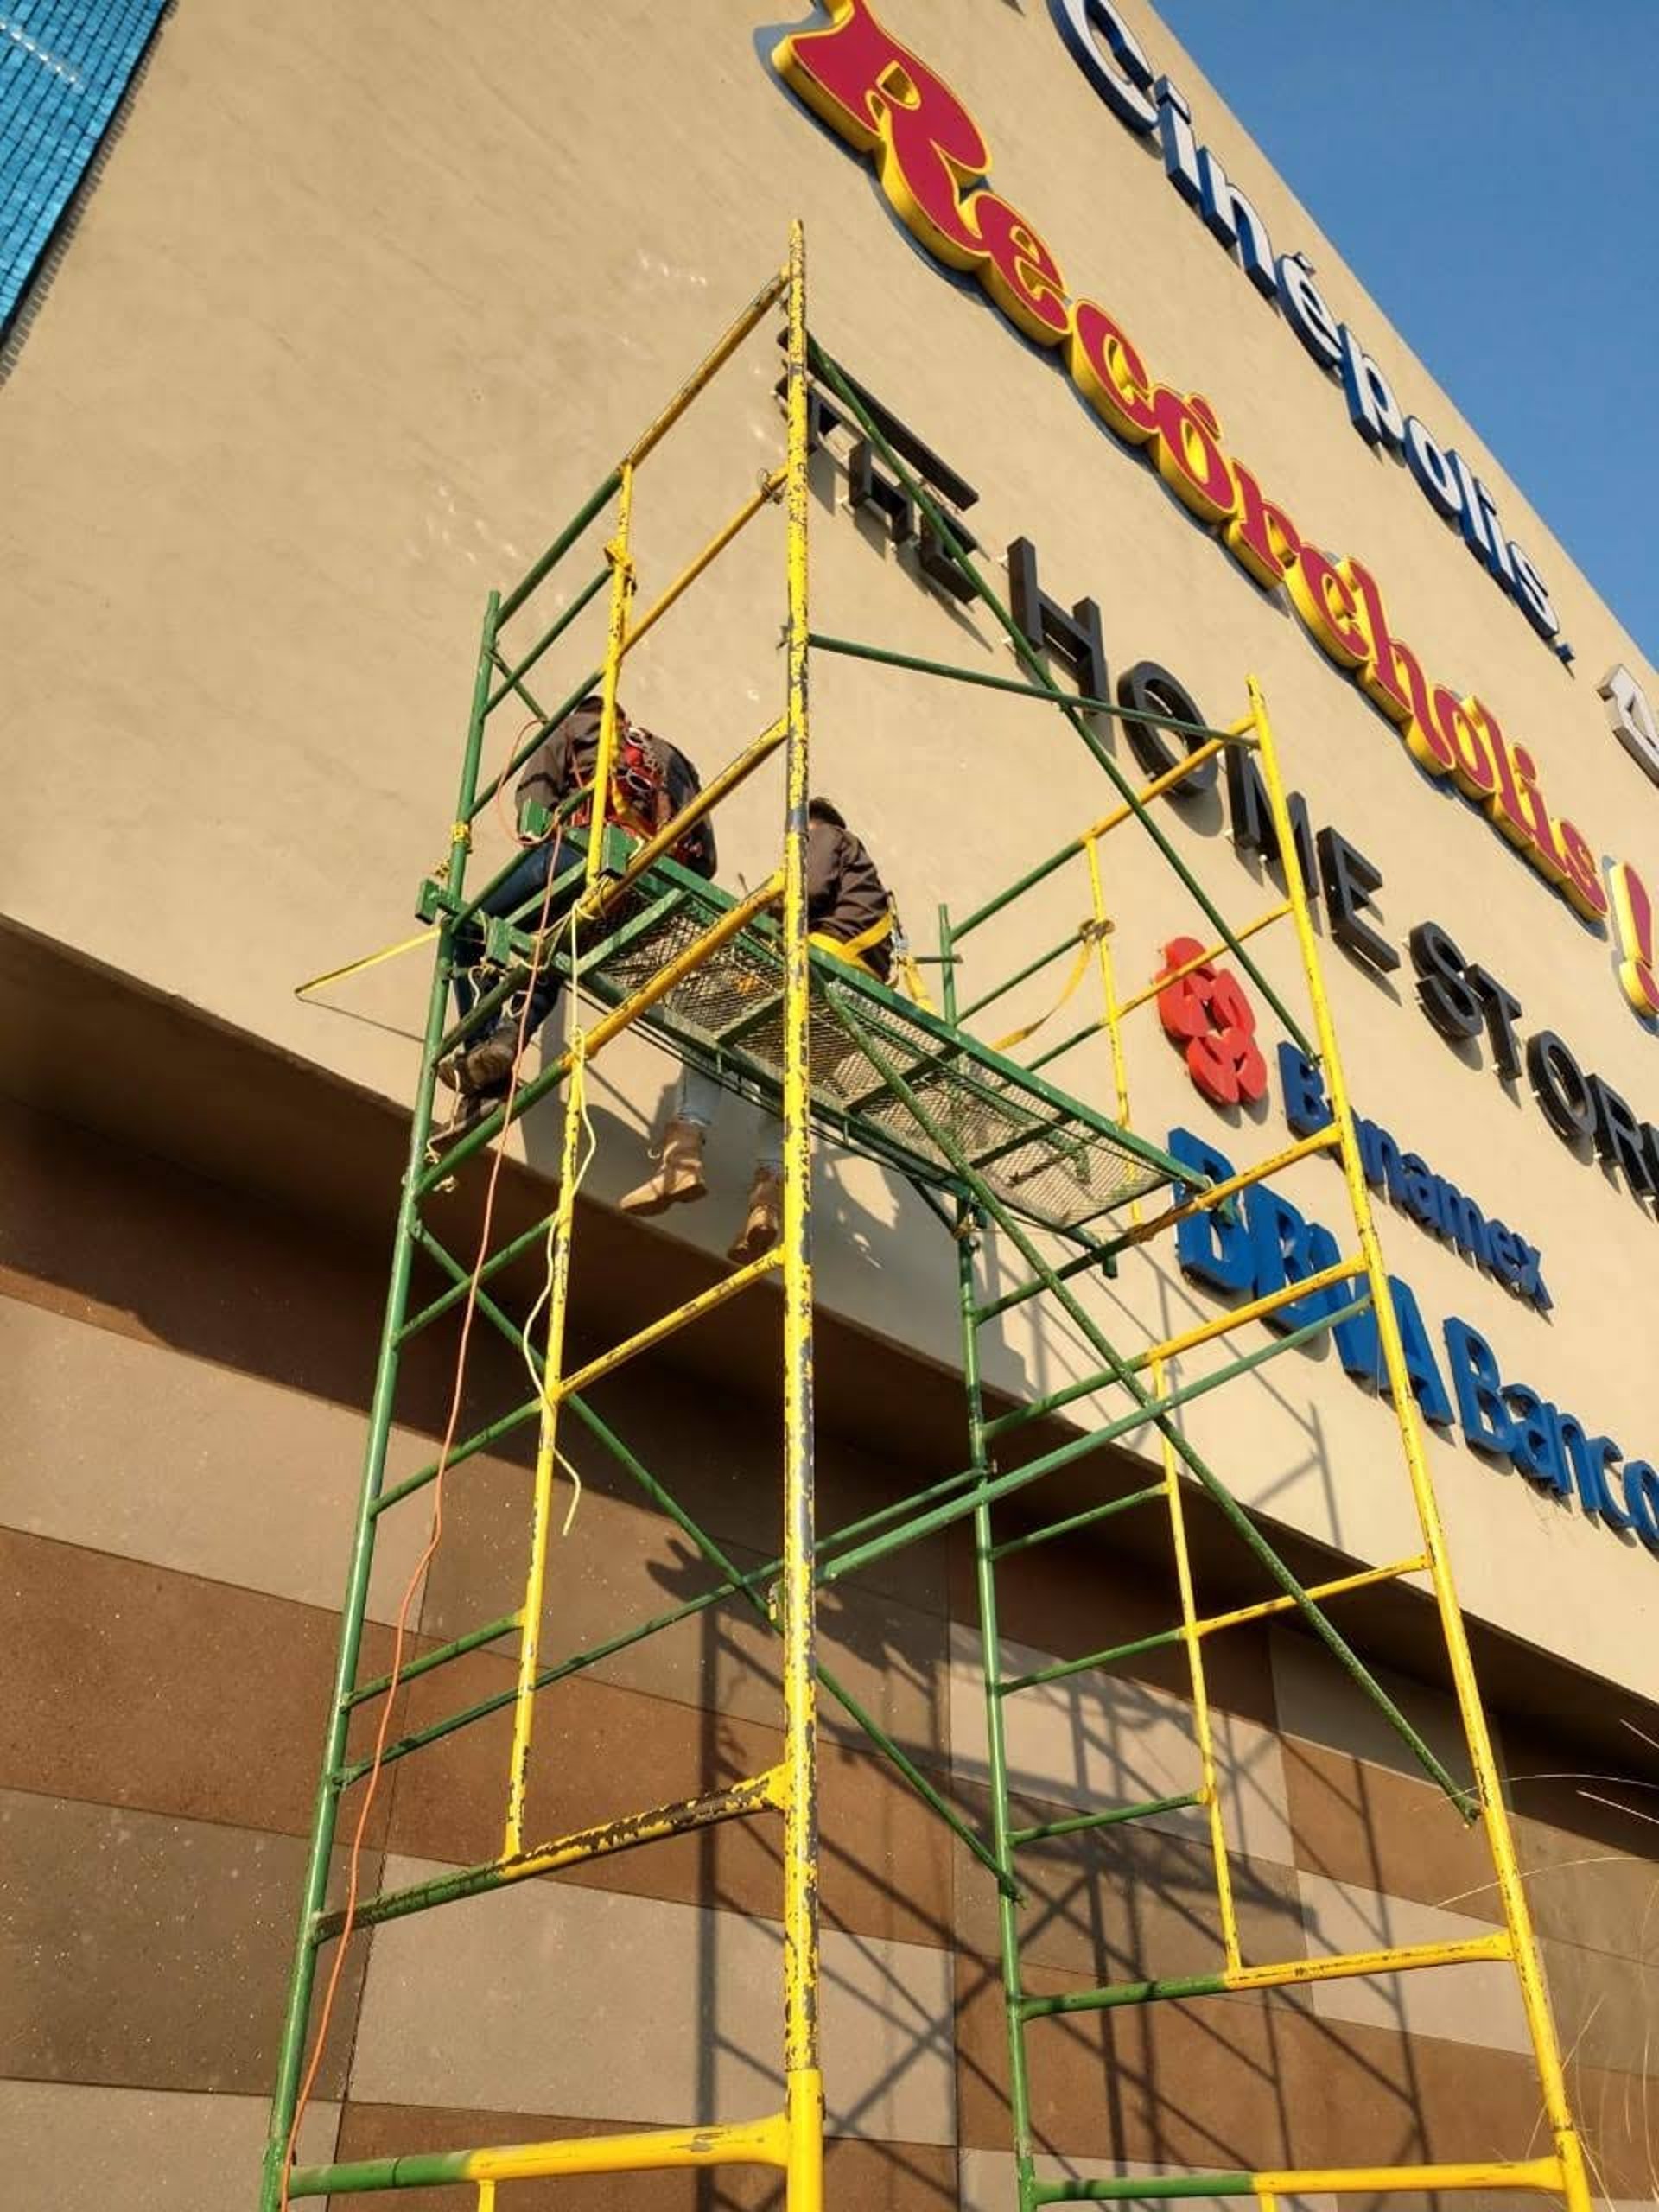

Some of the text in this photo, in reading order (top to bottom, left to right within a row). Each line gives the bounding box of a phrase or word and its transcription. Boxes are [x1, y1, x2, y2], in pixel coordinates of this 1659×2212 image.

[1006, 536, 1401, 973] HOME
[1168, 1127, 1456, 1431] BBVA
[1277, 1040, 1554, 1311] Bnamex
